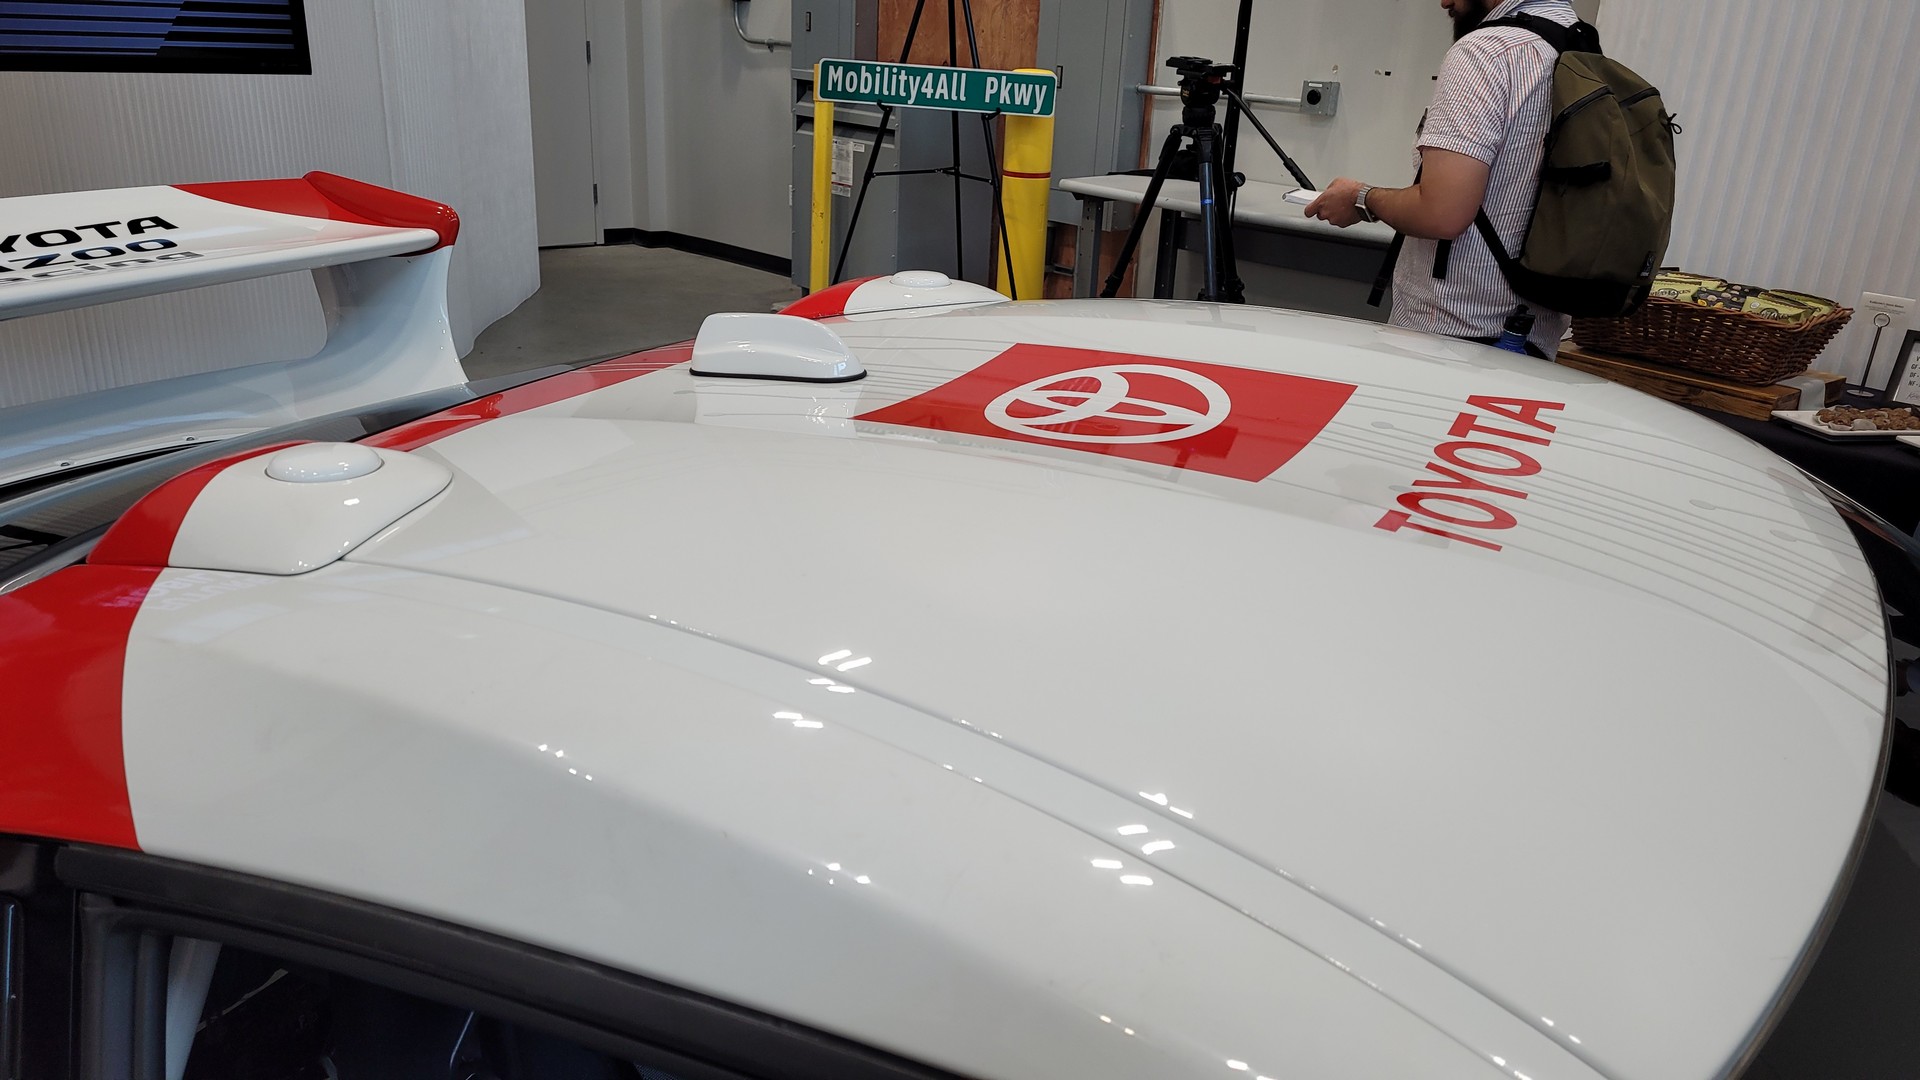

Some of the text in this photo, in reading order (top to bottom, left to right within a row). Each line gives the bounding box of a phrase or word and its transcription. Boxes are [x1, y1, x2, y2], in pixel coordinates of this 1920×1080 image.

[827, 65, 1048, 114] Mobility4All Pkwy
[0, 238, 178, 274] ZOO
[1373, 394, 1566, 552] TOYOTA
